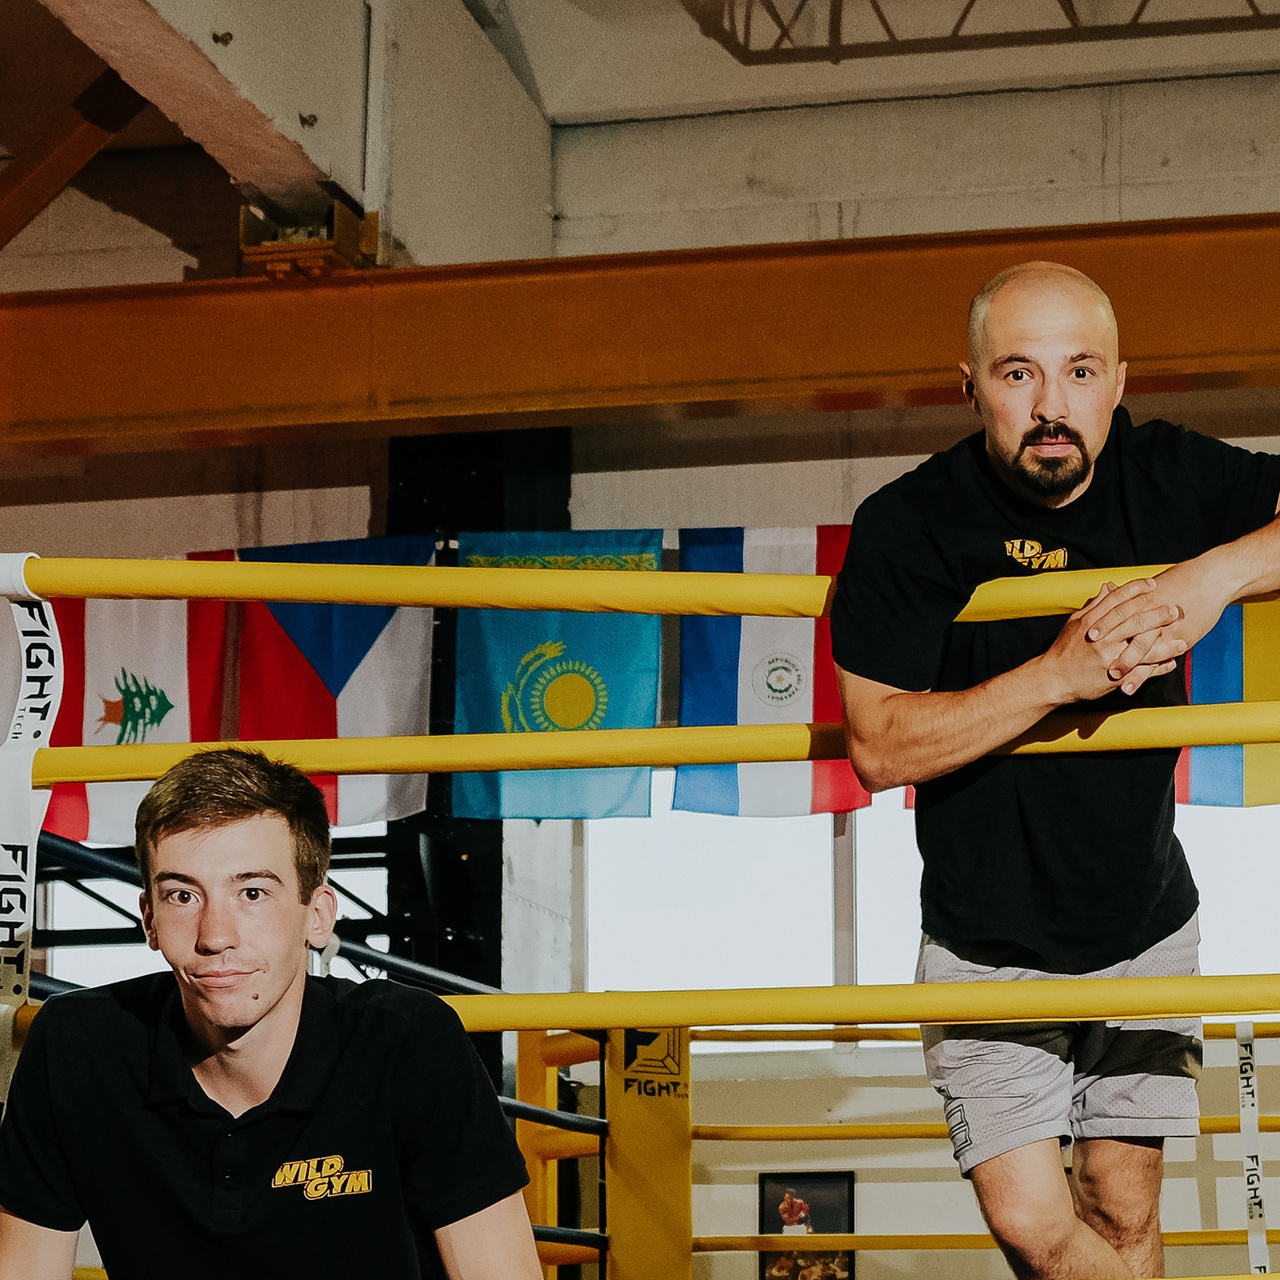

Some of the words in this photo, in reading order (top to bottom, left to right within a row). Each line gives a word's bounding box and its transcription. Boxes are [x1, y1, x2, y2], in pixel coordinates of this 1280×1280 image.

[15, 601, 55, 721] FIGHT
[12, 707, 26, 740] TECH
[0, 844, 29, 974] FIGHT
[624, 1078, 681, 1097] FIGHT
[1240, 1043, 1255, 1098] FIGHT
[275, 1157, 343, 1186] WILD
[306, 1172, 369, 1198] GYM
[1246, 1155, 1262, 1209] FIGHT
